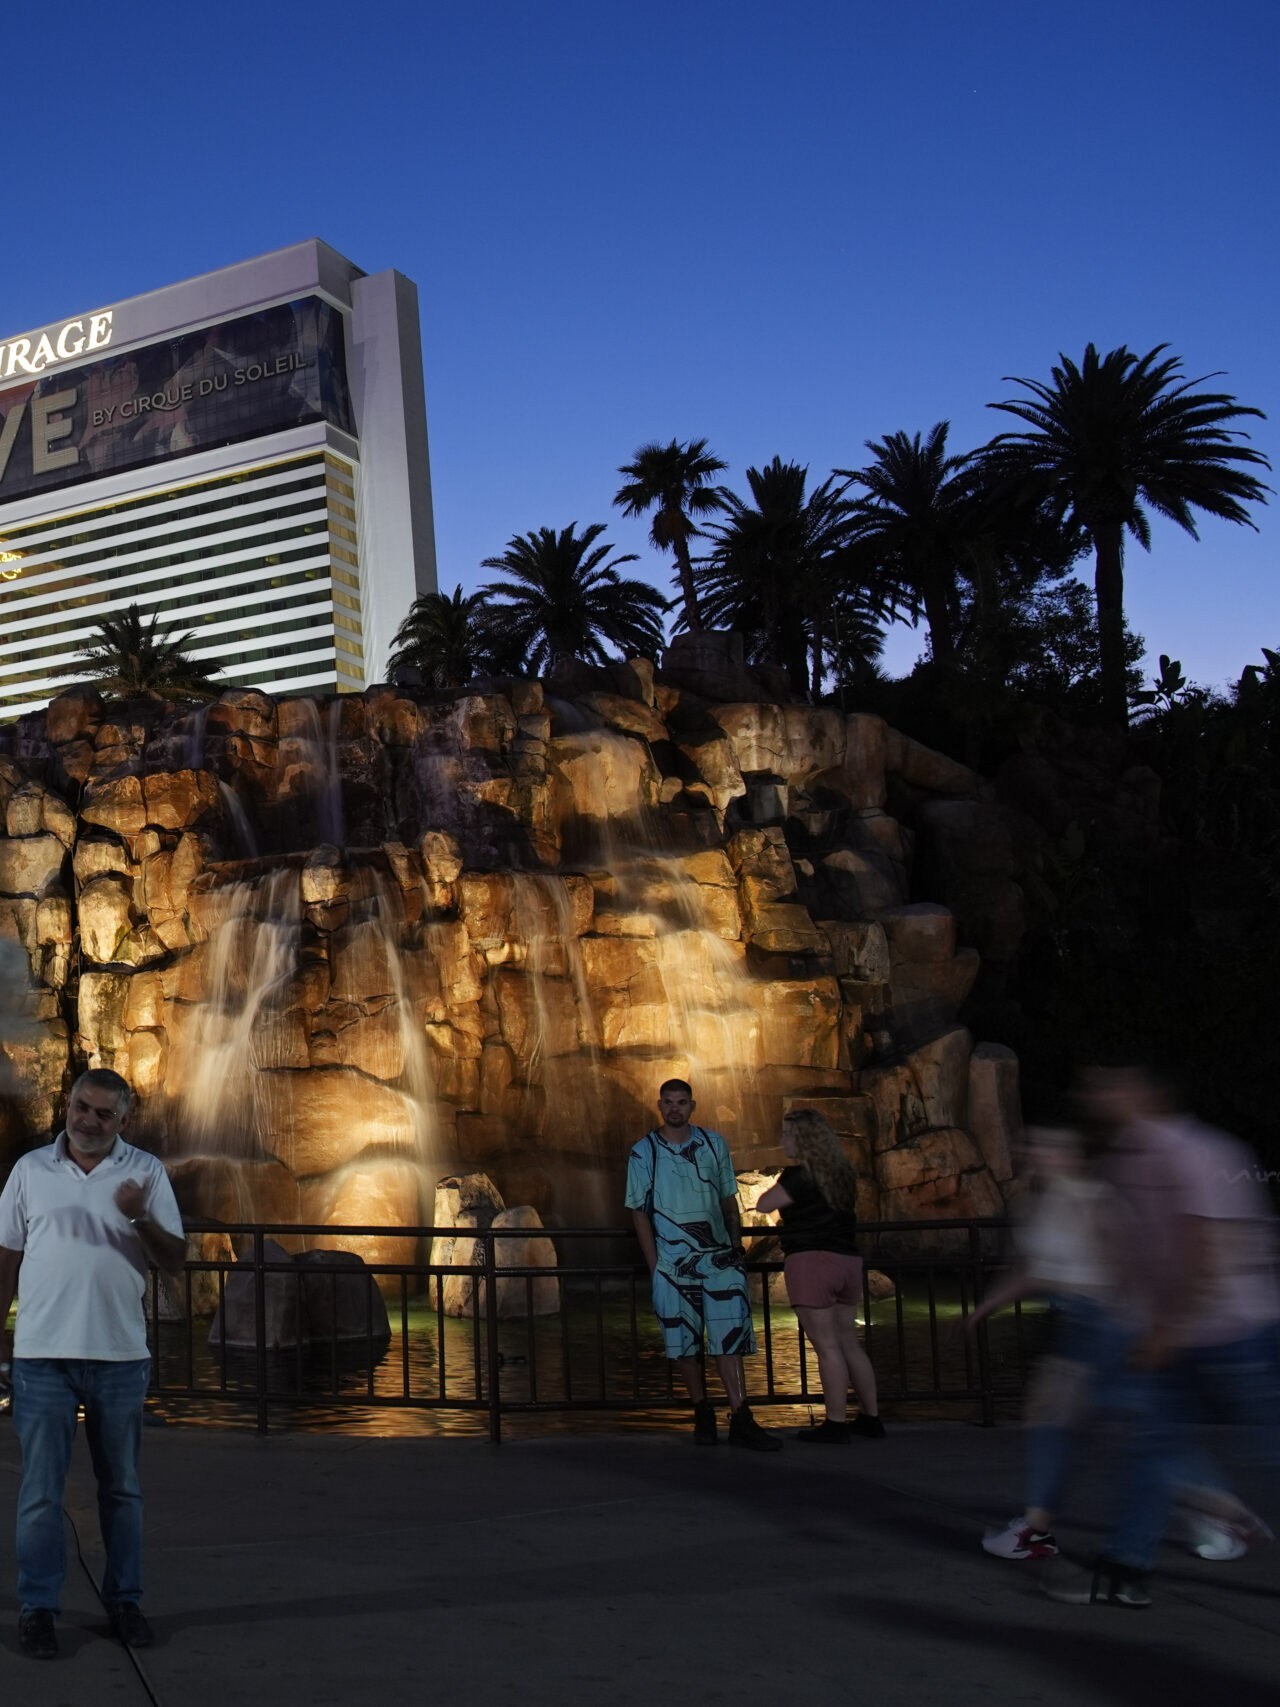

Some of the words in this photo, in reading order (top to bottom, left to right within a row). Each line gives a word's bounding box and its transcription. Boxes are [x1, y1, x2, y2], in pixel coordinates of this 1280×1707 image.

[93, 404, 116, 427] BY
[120, 384, 192, 418] CIRQUE
[199, 373, 228, 397] DU
[234, 352, 306, 386] SOLEIL
